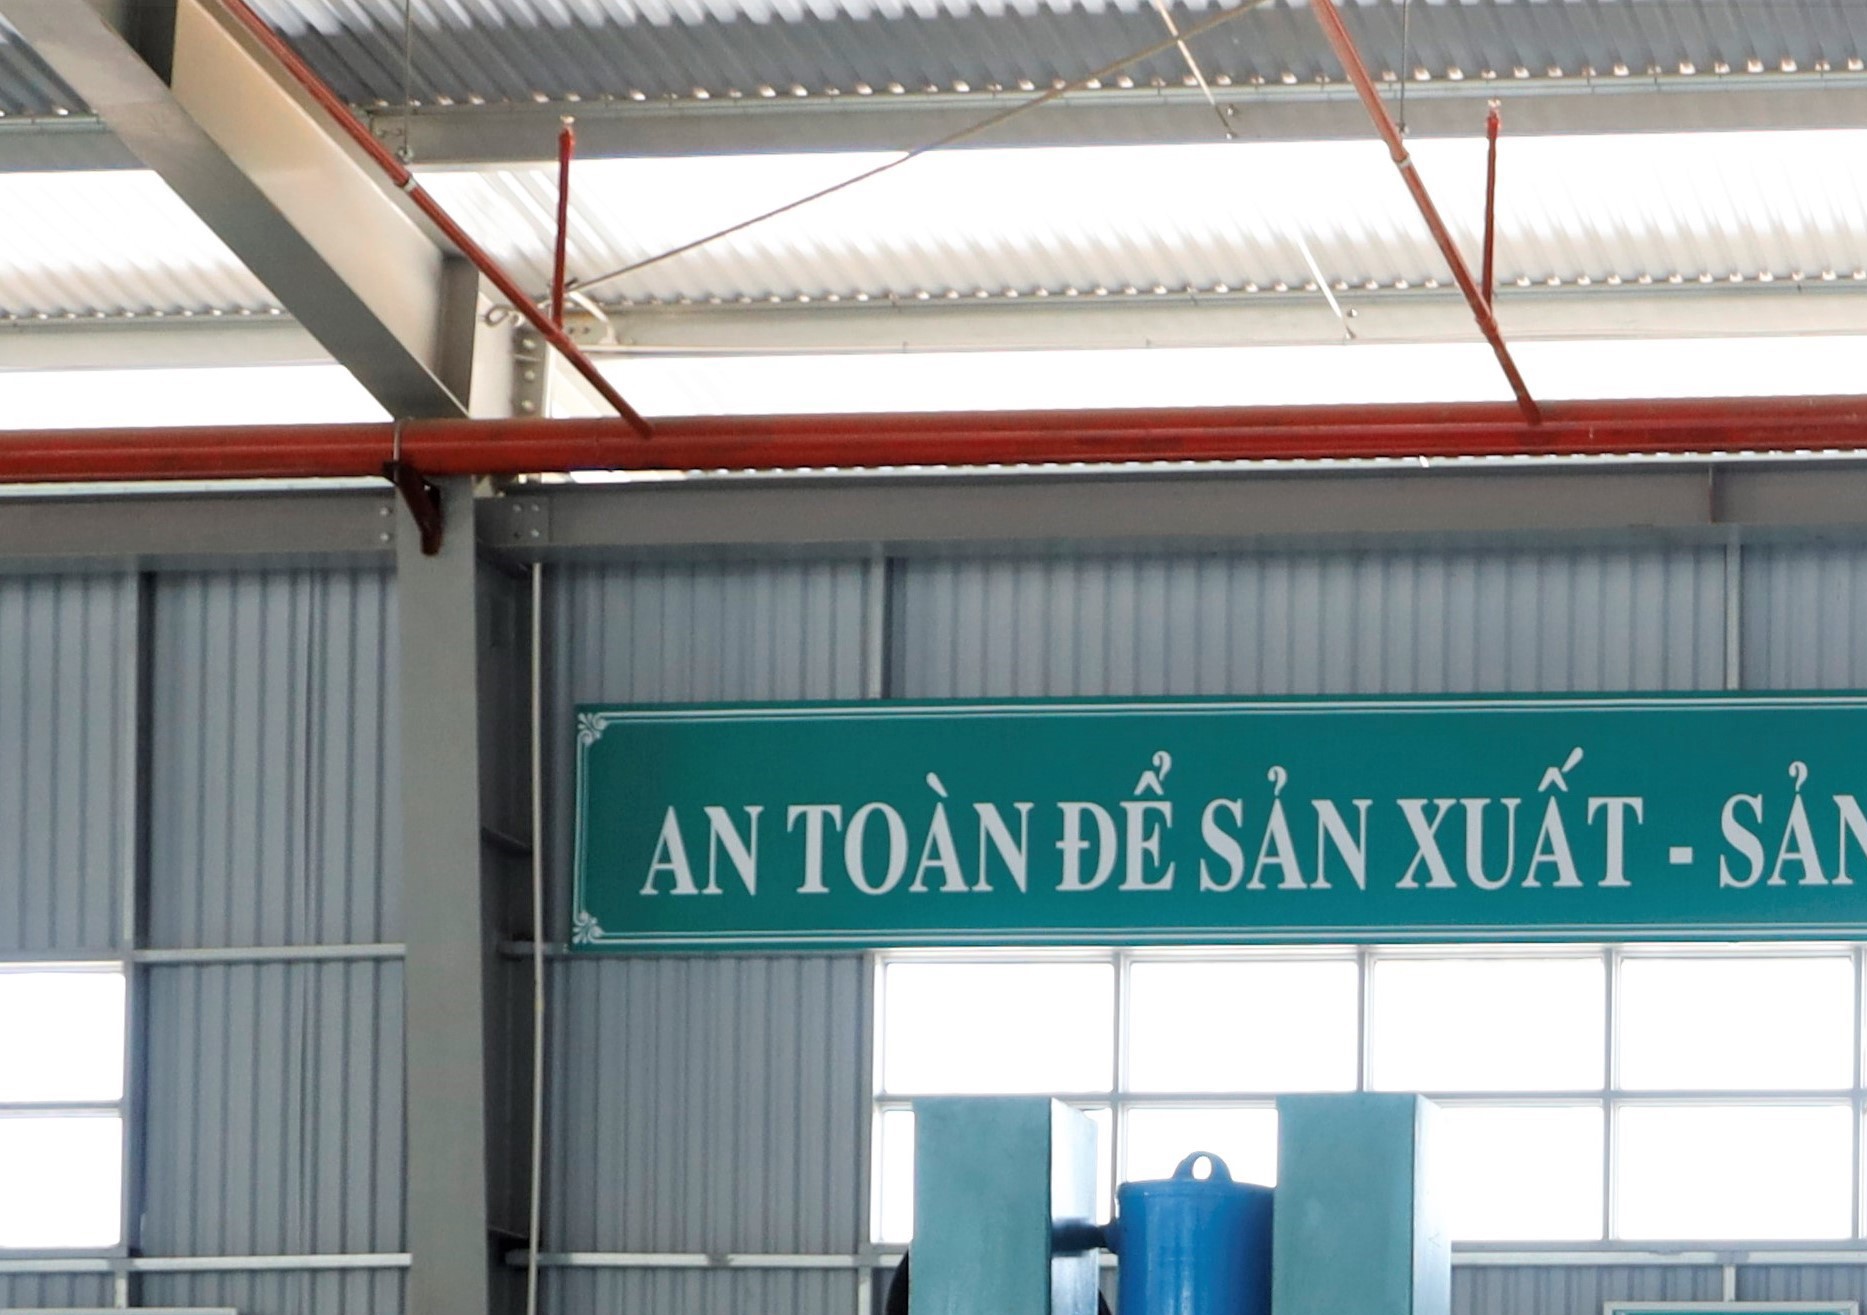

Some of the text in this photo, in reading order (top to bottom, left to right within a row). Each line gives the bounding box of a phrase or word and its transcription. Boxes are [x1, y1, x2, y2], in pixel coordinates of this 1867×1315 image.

[640, 805, 763, 896] AN
[787, 772, 1035, 896] TOÀN
[1055, 751, 1174, 892] ĐỂ
[1200, 765, 1372, 892] SẢN
[1396, 747, 1643, 890] XUẤT
[1669, 846, 1693, 864] -
